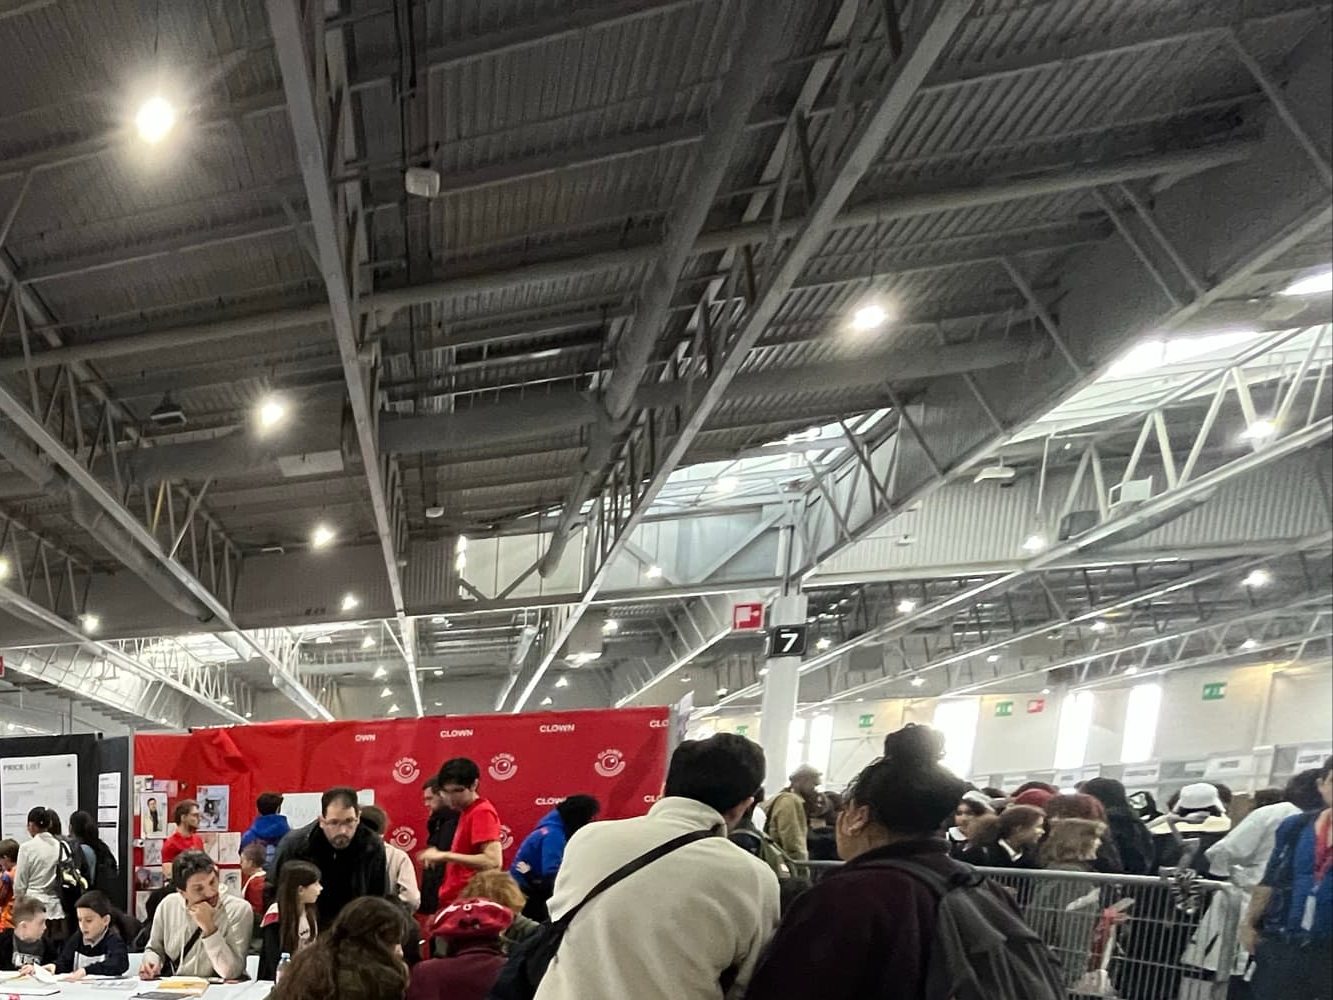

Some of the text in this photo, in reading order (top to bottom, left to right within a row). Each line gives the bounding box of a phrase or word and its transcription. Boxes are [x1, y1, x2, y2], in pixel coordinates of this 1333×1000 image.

[780, 633, 799, 652] 7
[539, 724, 575, 732] CLOWN
[440, 729, 474, 738] CLOWN
